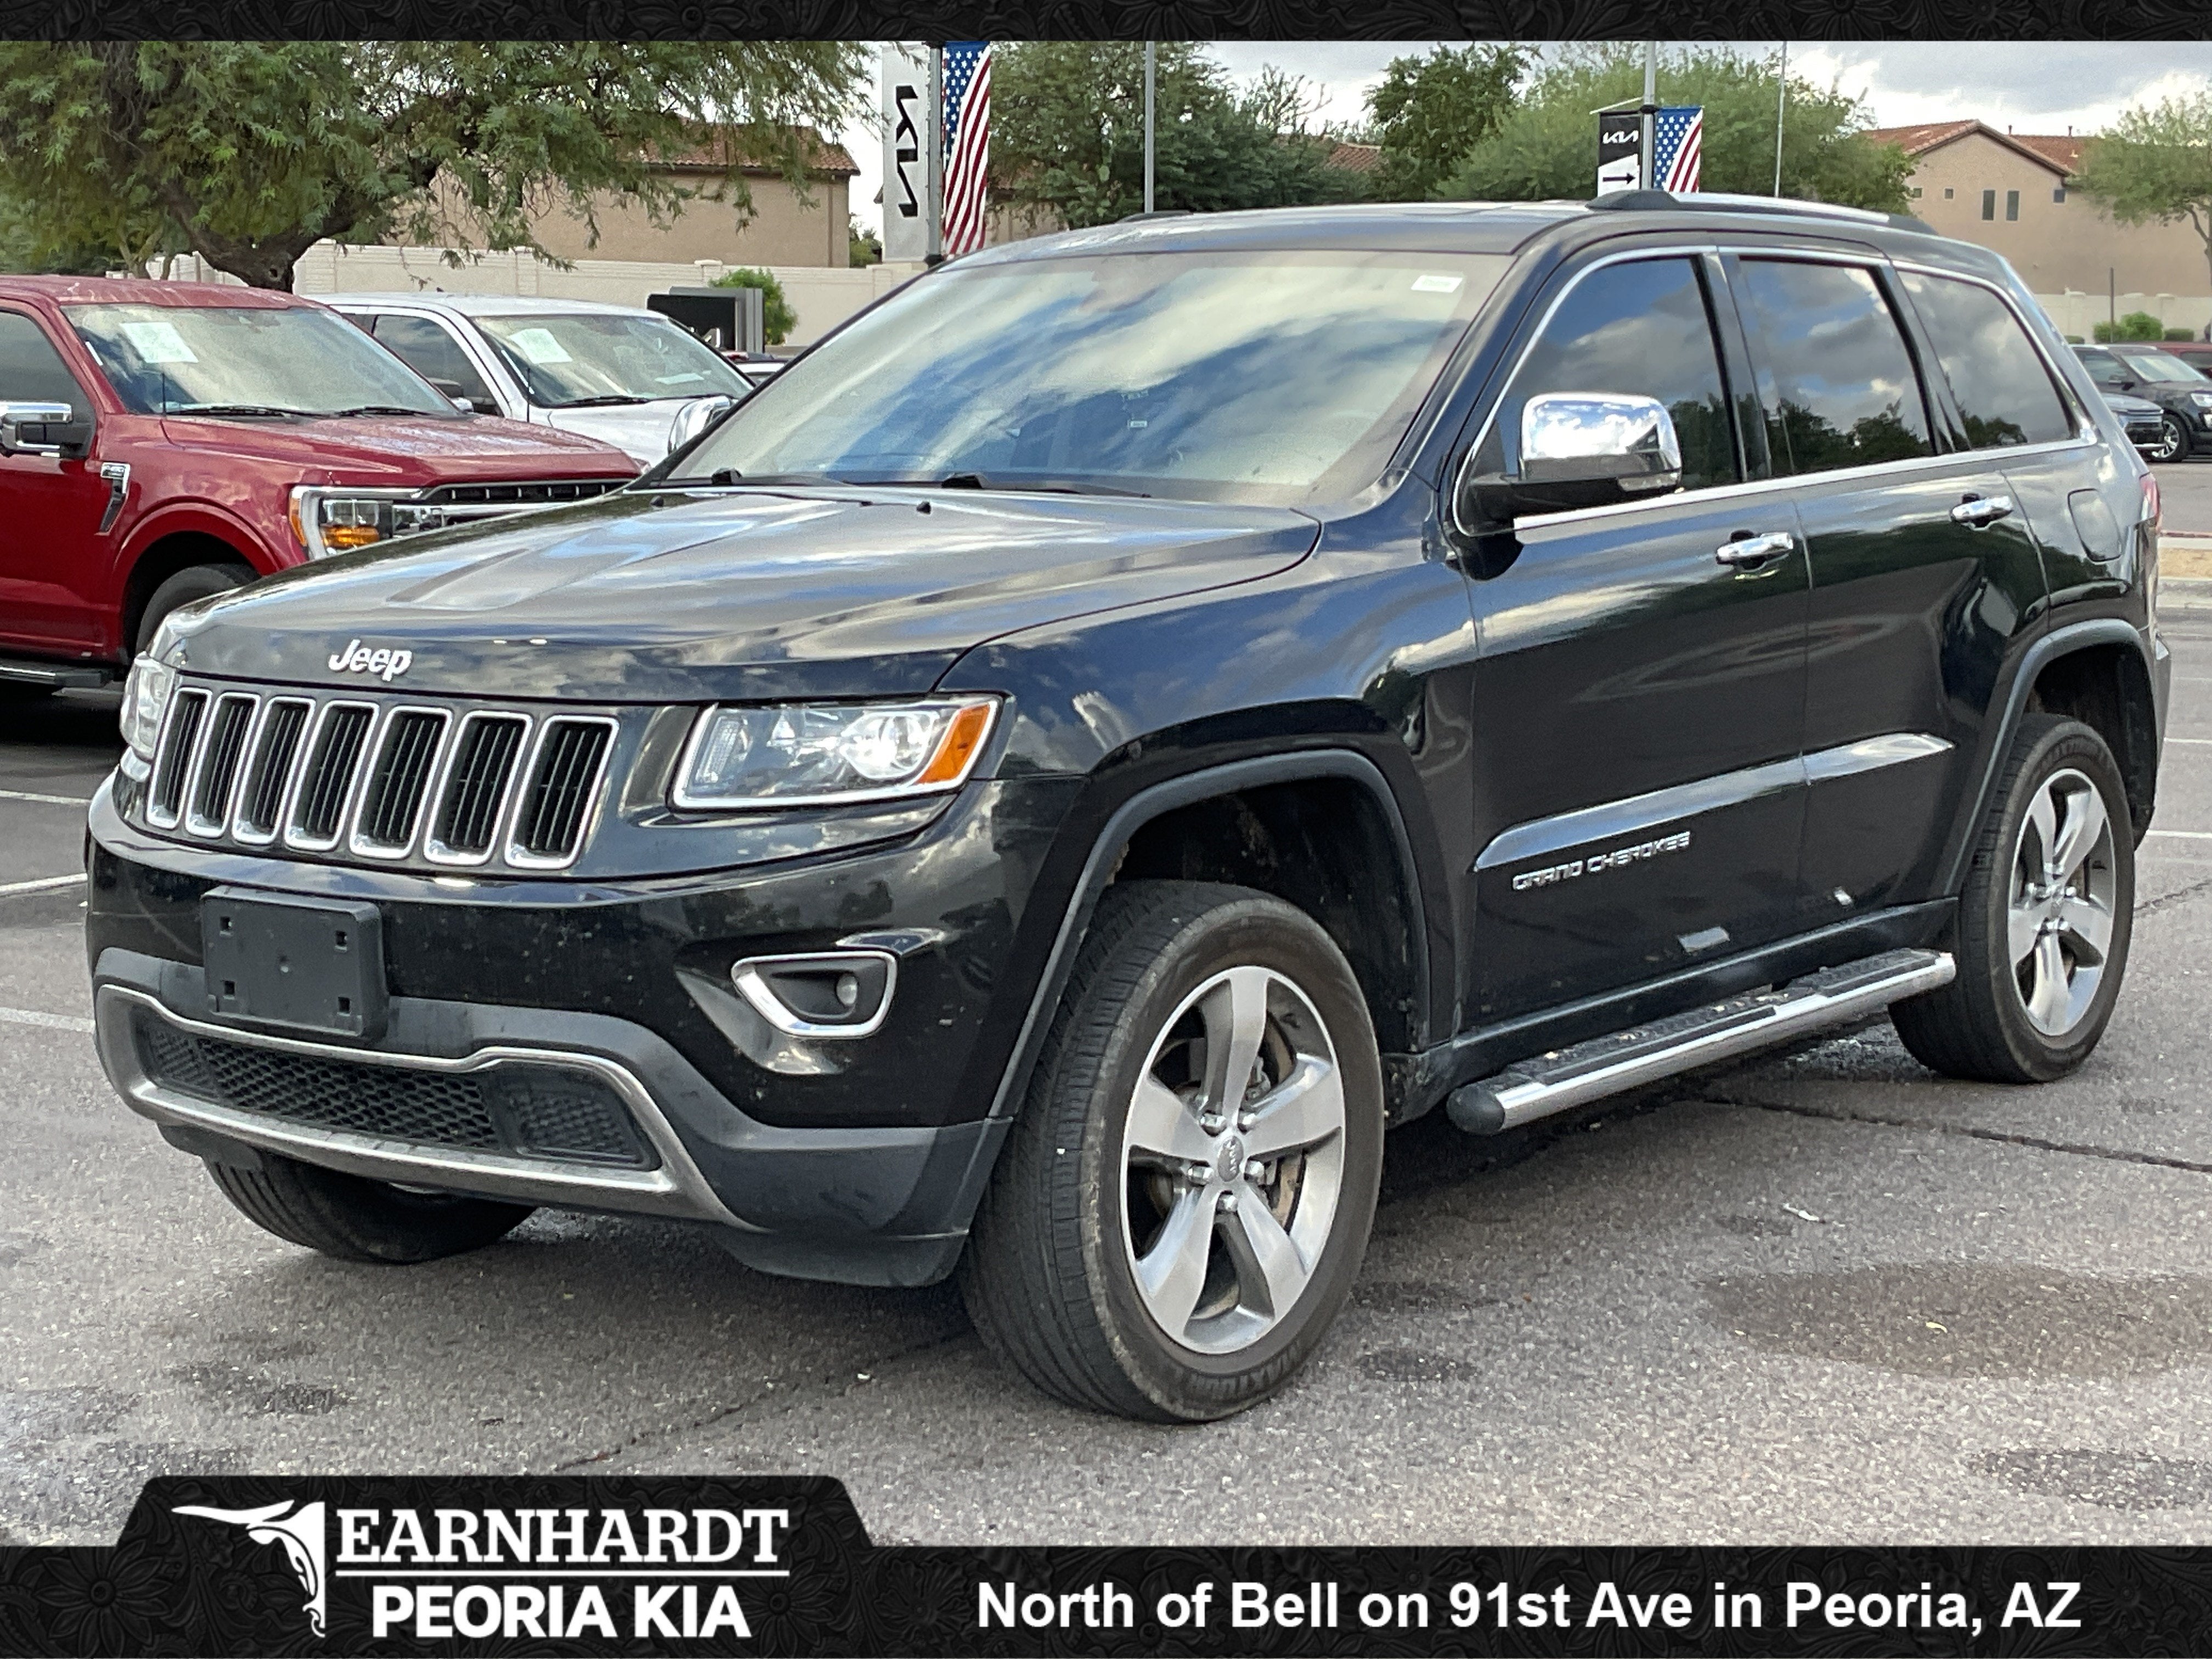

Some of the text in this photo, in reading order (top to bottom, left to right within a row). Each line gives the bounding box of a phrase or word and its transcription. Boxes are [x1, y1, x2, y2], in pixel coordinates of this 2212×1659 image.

[895, 85, 918, 217] KIA
[1602, 129, 1639, 144] KIA
[328, 639, 413, 682] Jeep
[1512, 831, 1691, 890] GRAND CHEROKEE
